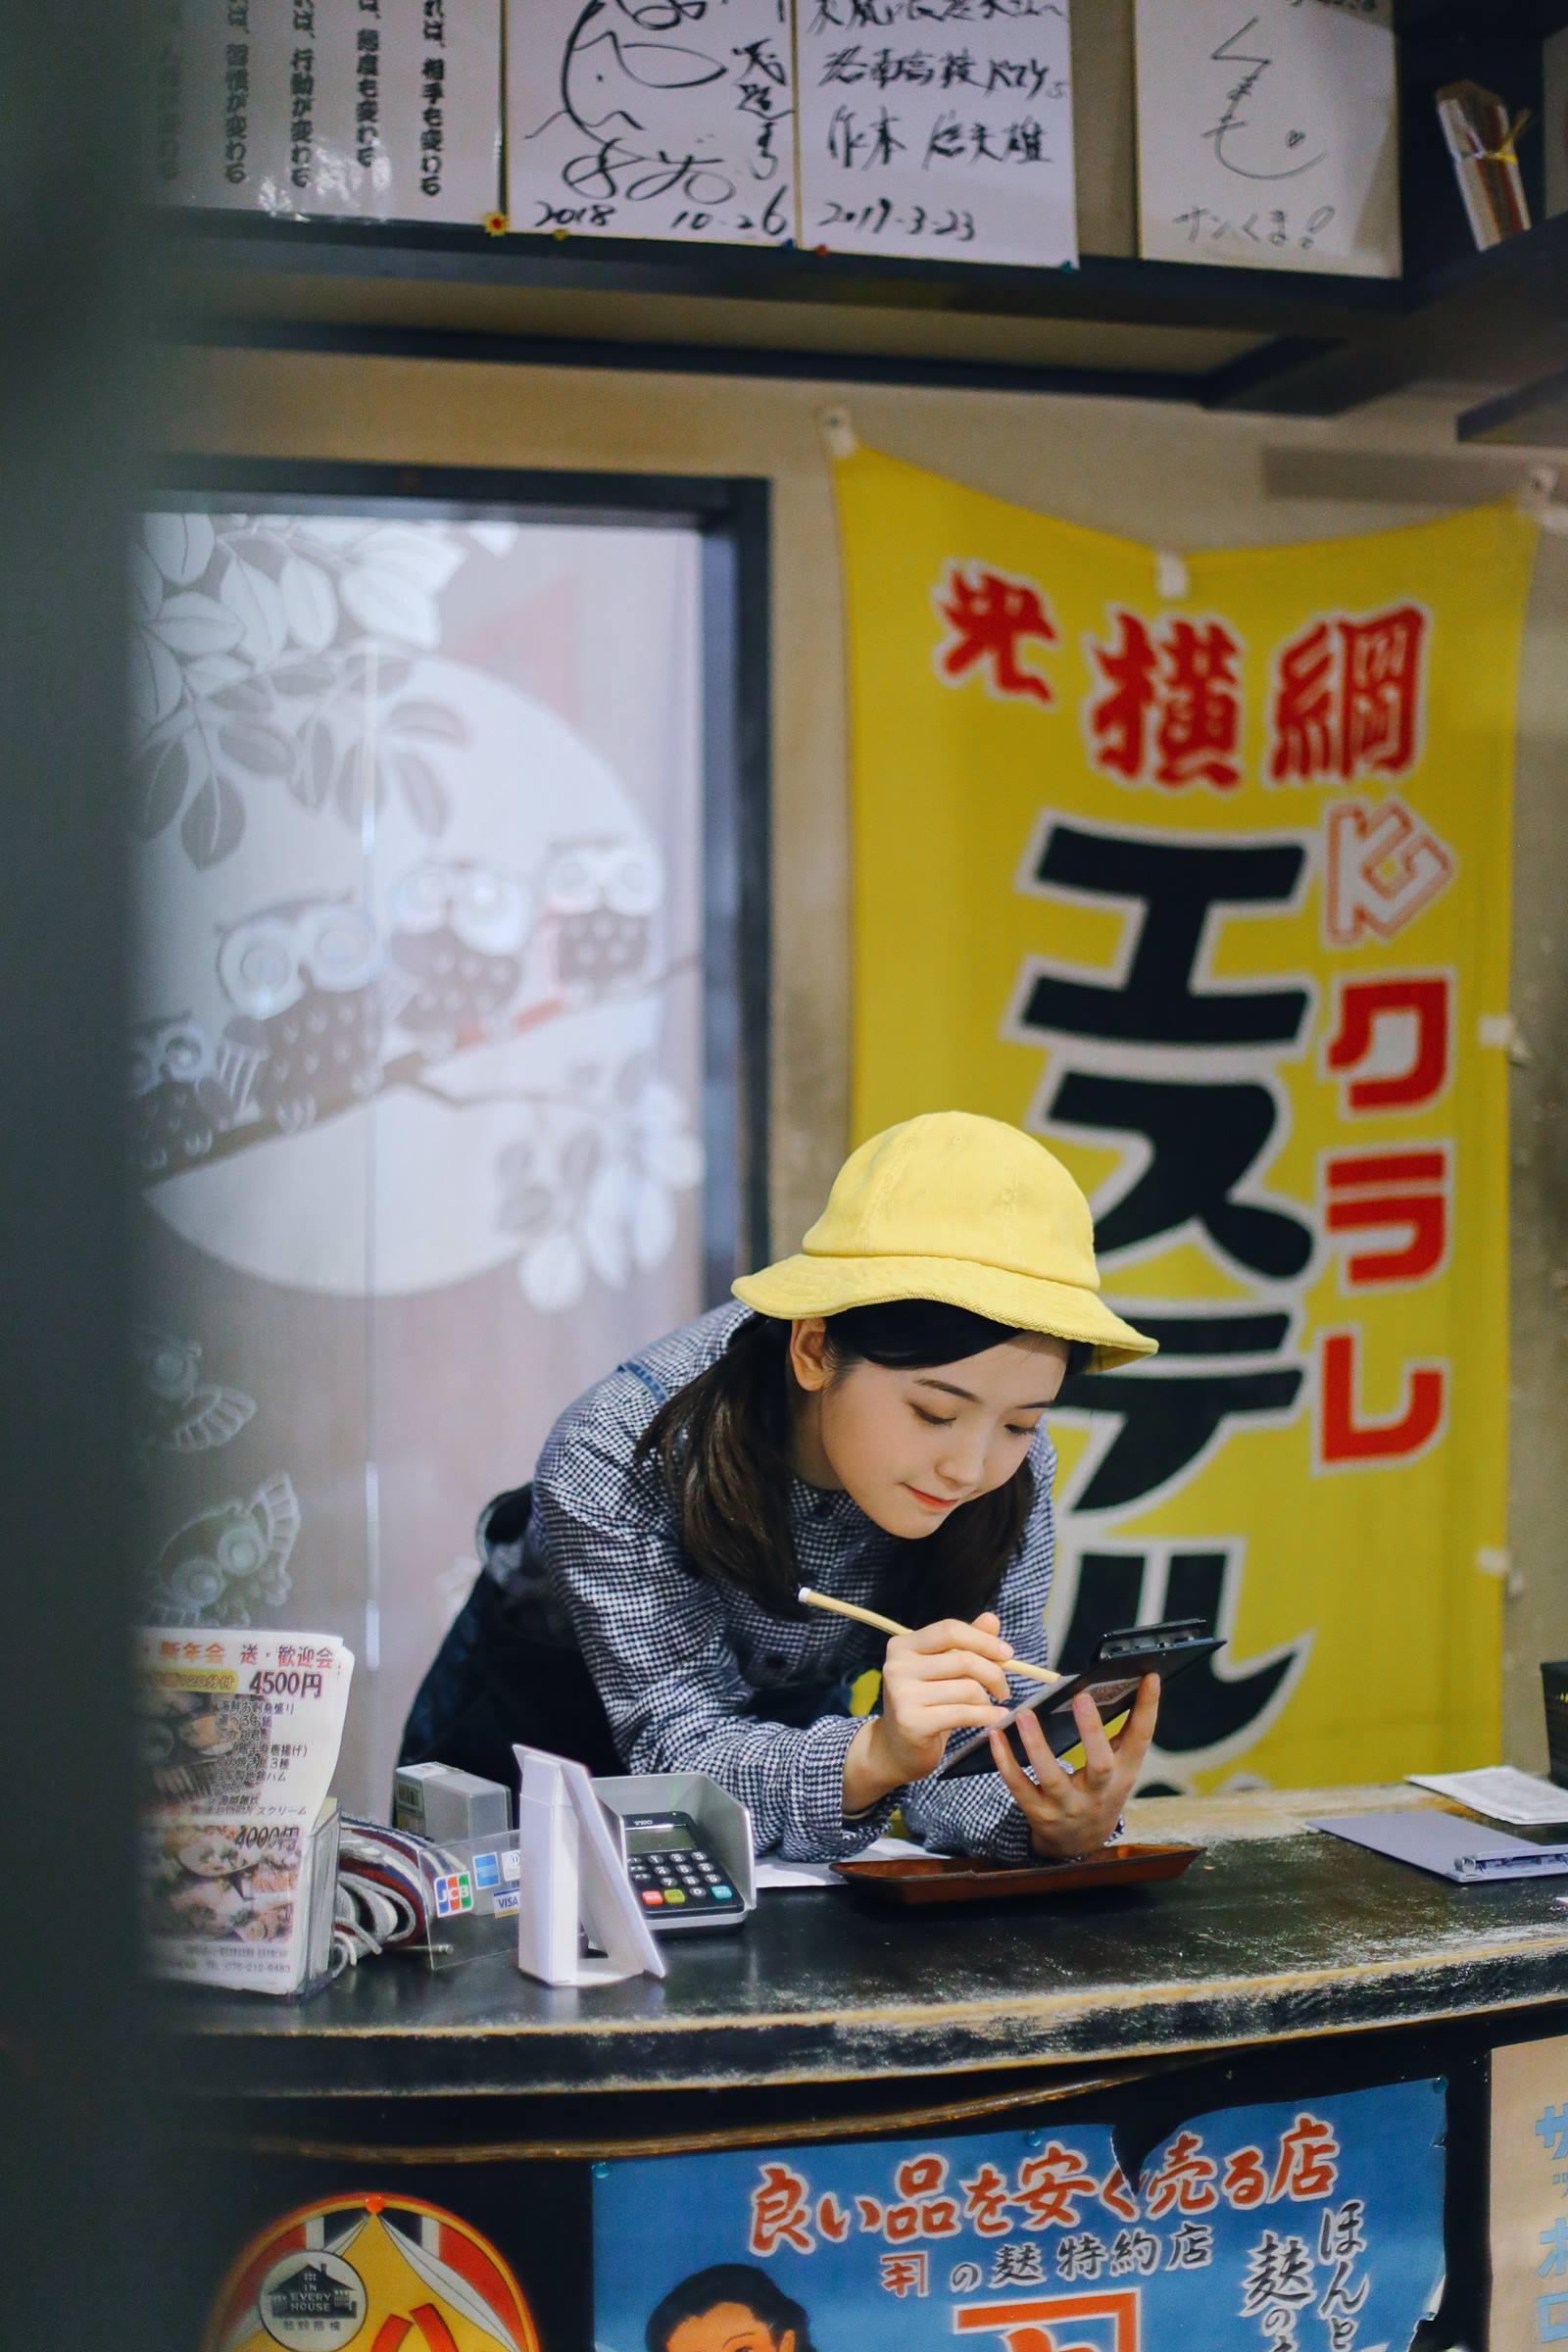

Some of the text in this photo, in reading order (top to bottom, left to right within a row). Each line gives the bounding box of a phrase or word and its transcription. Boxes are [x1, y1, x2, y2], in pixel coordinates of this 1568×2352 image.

[249, 1670, 322, 1699] 4500円
[436, 1884, 469, 1903] JCB
[498, 1896, 518, 1909] VISA
[750, 2115, 1338, 2253] 良い品を安く売る店
[290, 2293, 331, 2302] EVERY
[290, 2303, 331, 2312] HOUSE
